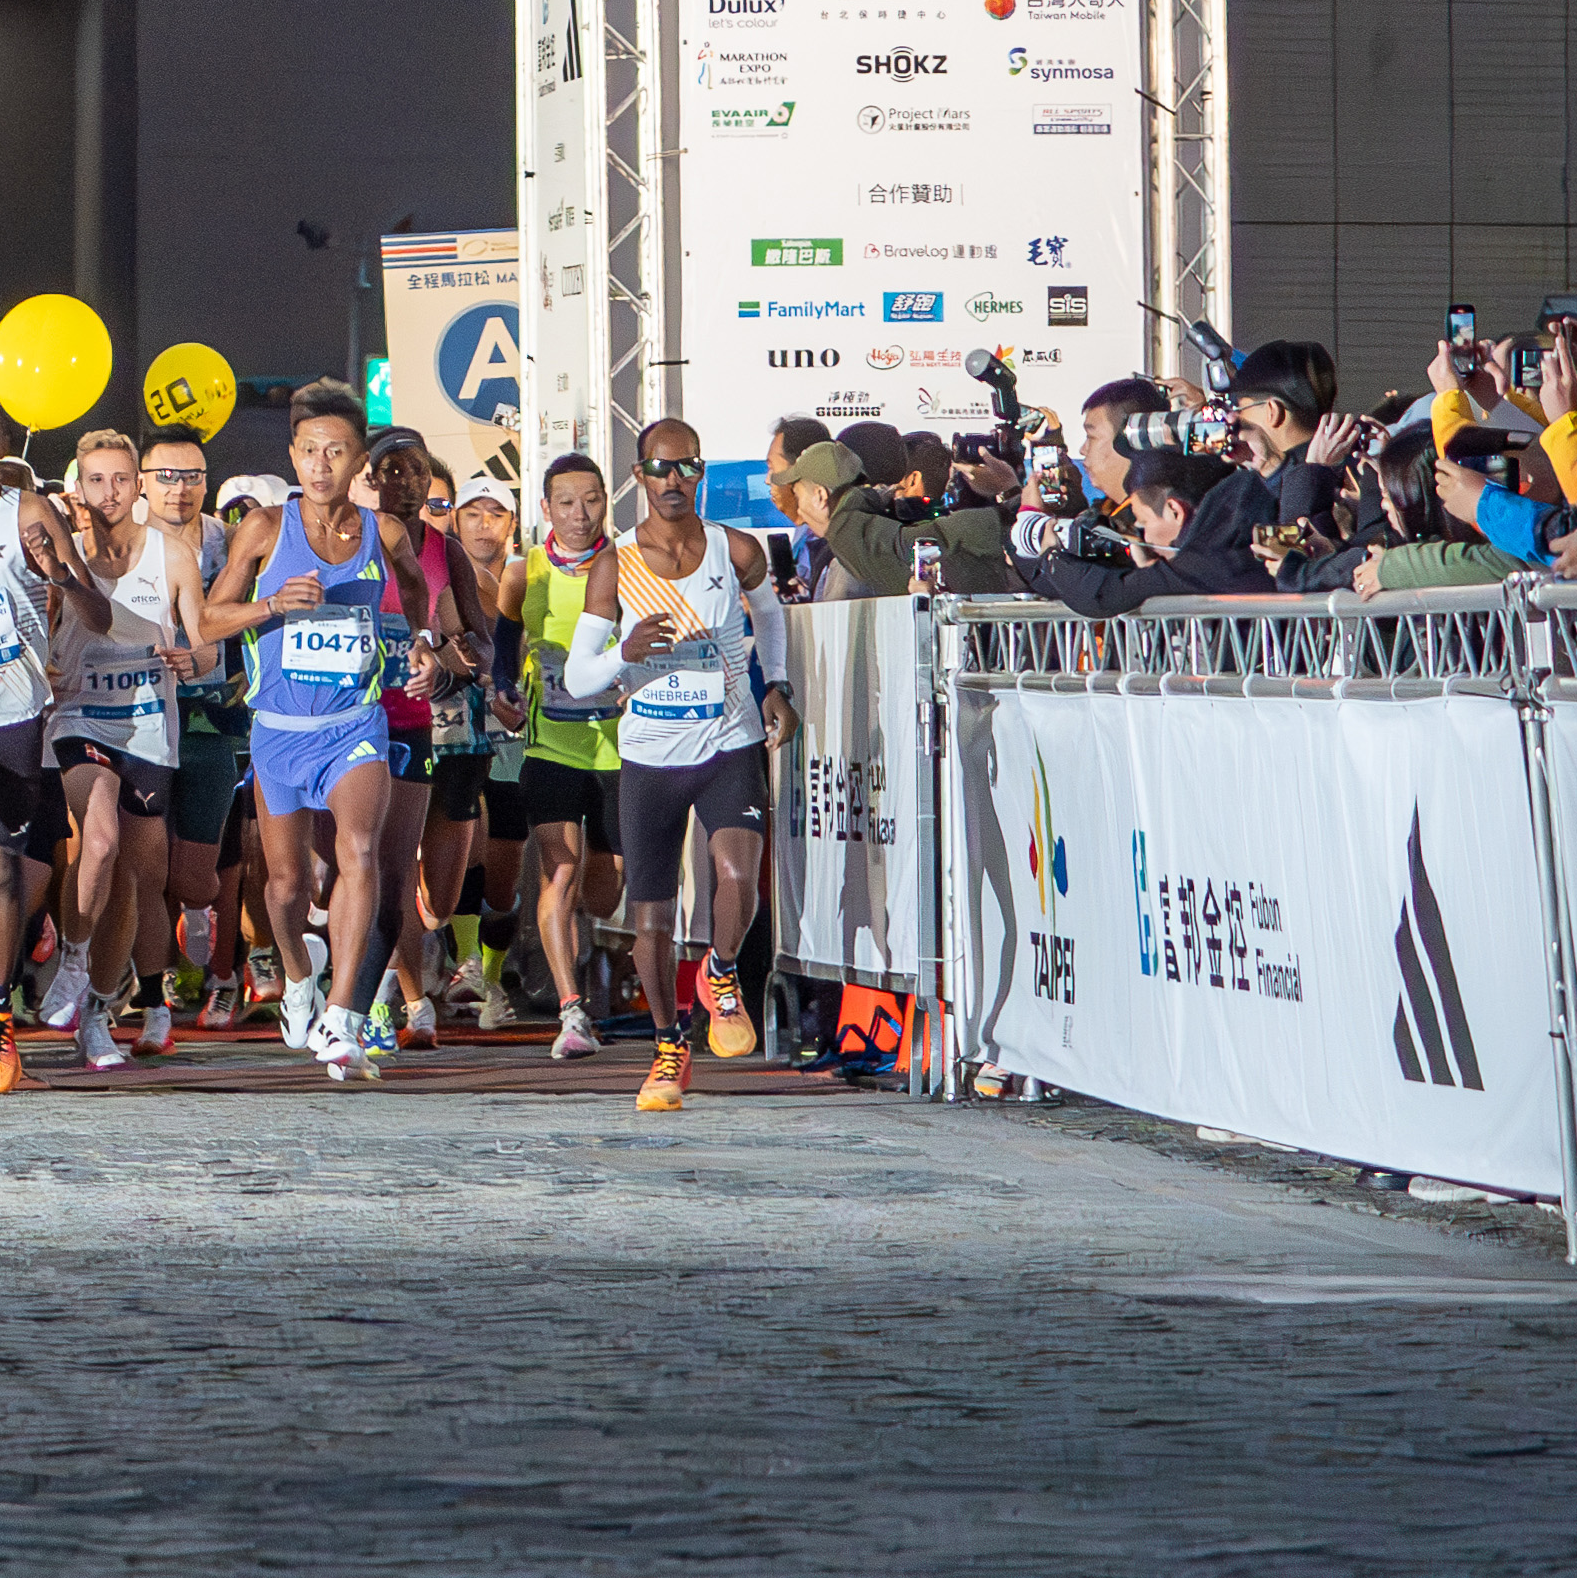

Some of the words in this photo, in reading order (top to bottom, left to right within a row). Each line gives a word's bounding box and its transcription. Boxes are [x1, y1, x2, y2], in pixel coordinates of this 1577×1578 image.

[708, 17, 734, 28] let's
[737, 17, 779, 28] colour
[1027, 10, 1067, 21] Taiwan
[1070, 10, 1106, 20] Mobile
[719, 52, 788, 62] MARATHON
[856, 54, 948, 75] SHOKZ
[739, 64, 771, 73] EXPO
[1030, 65, 1115, 82] synmosa
[711, 109, 741, 118] EVA
[742, 109, 769, 117] AIR
[888, 108, 934, 122] Project
[884, 244, 949, 260] Bravelog
[407, 270, 490, 290] 全程馬拉松
[767, 301, 866, 320] FamilyMart
[889, 293, 937, 312] 舒跑
[973, 300, 1024, 314] HERMES
[458, 316, 520, 400] A
[767, 348, 840, 368] uno
[290, 631, 372, 654] 10478
[86, 670, 163, 692] 11005
[668, 674, 680, 689] 8
[642, 688, 709, 702] GHEBREAB
[1248, 881, 1284, 933] Fubon
[1029, 930, 1076, 1006] TAIPEI
[1255, 947, 1305, 1004] Financial
